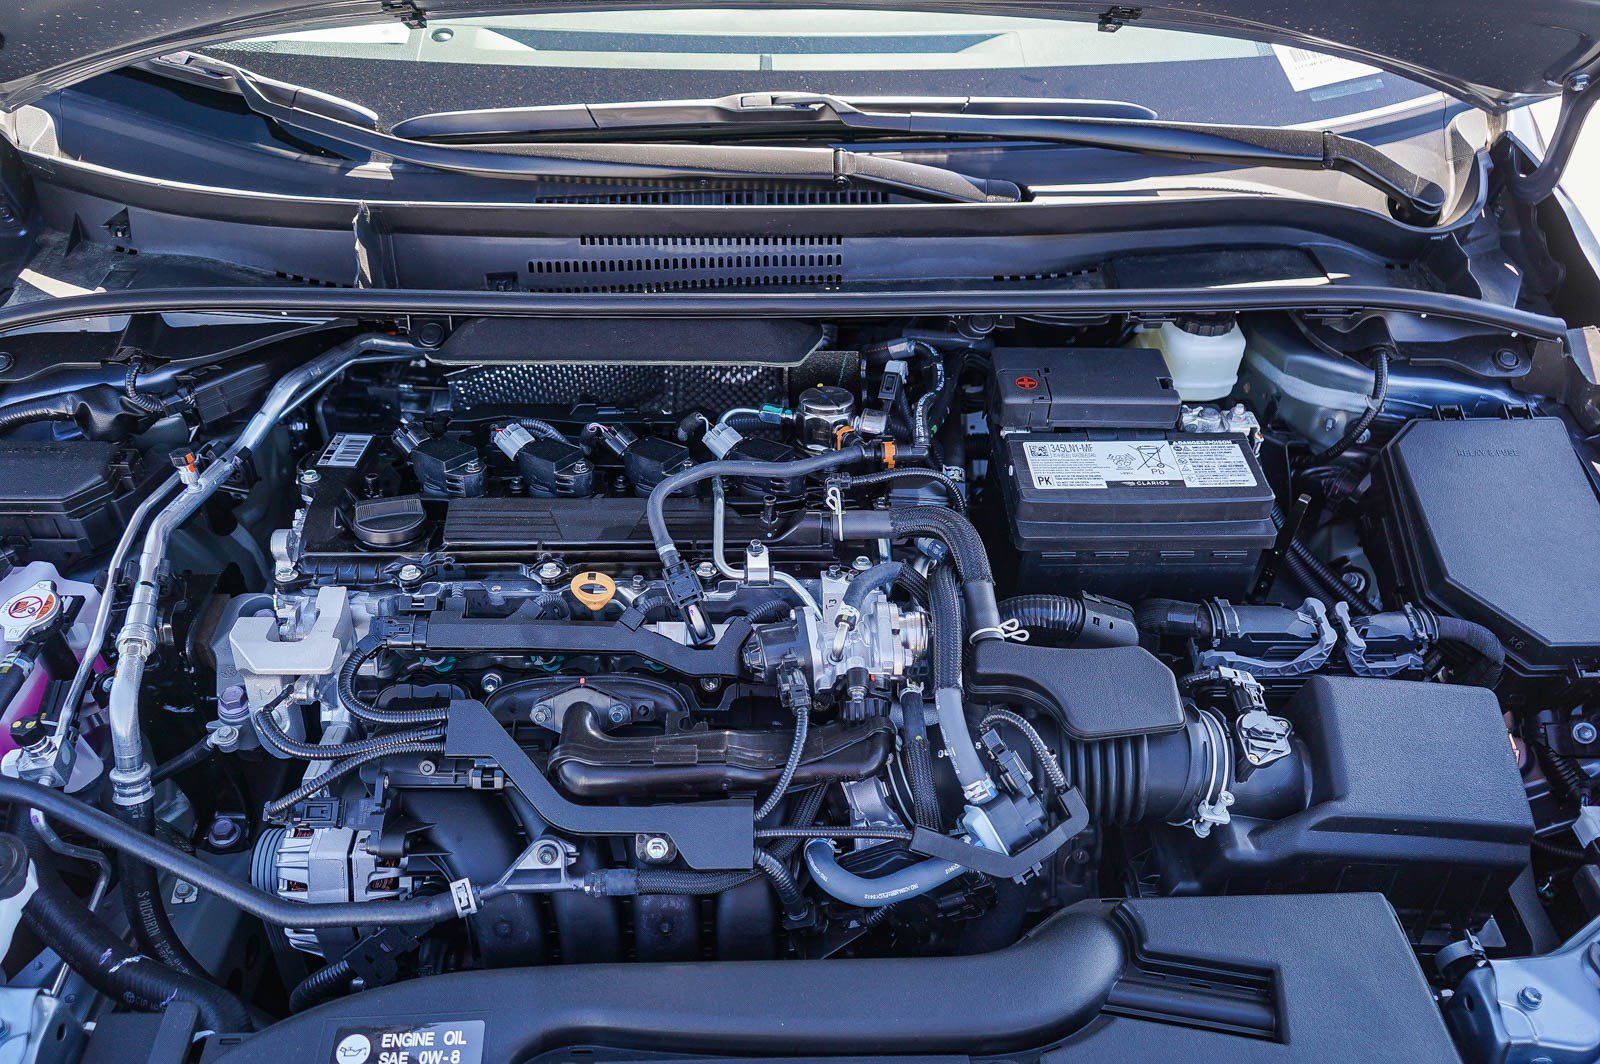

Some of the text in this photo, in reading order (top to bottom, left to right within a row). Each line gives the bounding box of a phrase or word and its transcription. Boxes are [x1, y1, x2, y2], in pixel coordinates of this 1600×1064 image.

[1037, 476, 1052, 486] PK
[381, 1031, 467, 1048] ENGINE OIL
[378, 1052, 410, 1064] SAE
